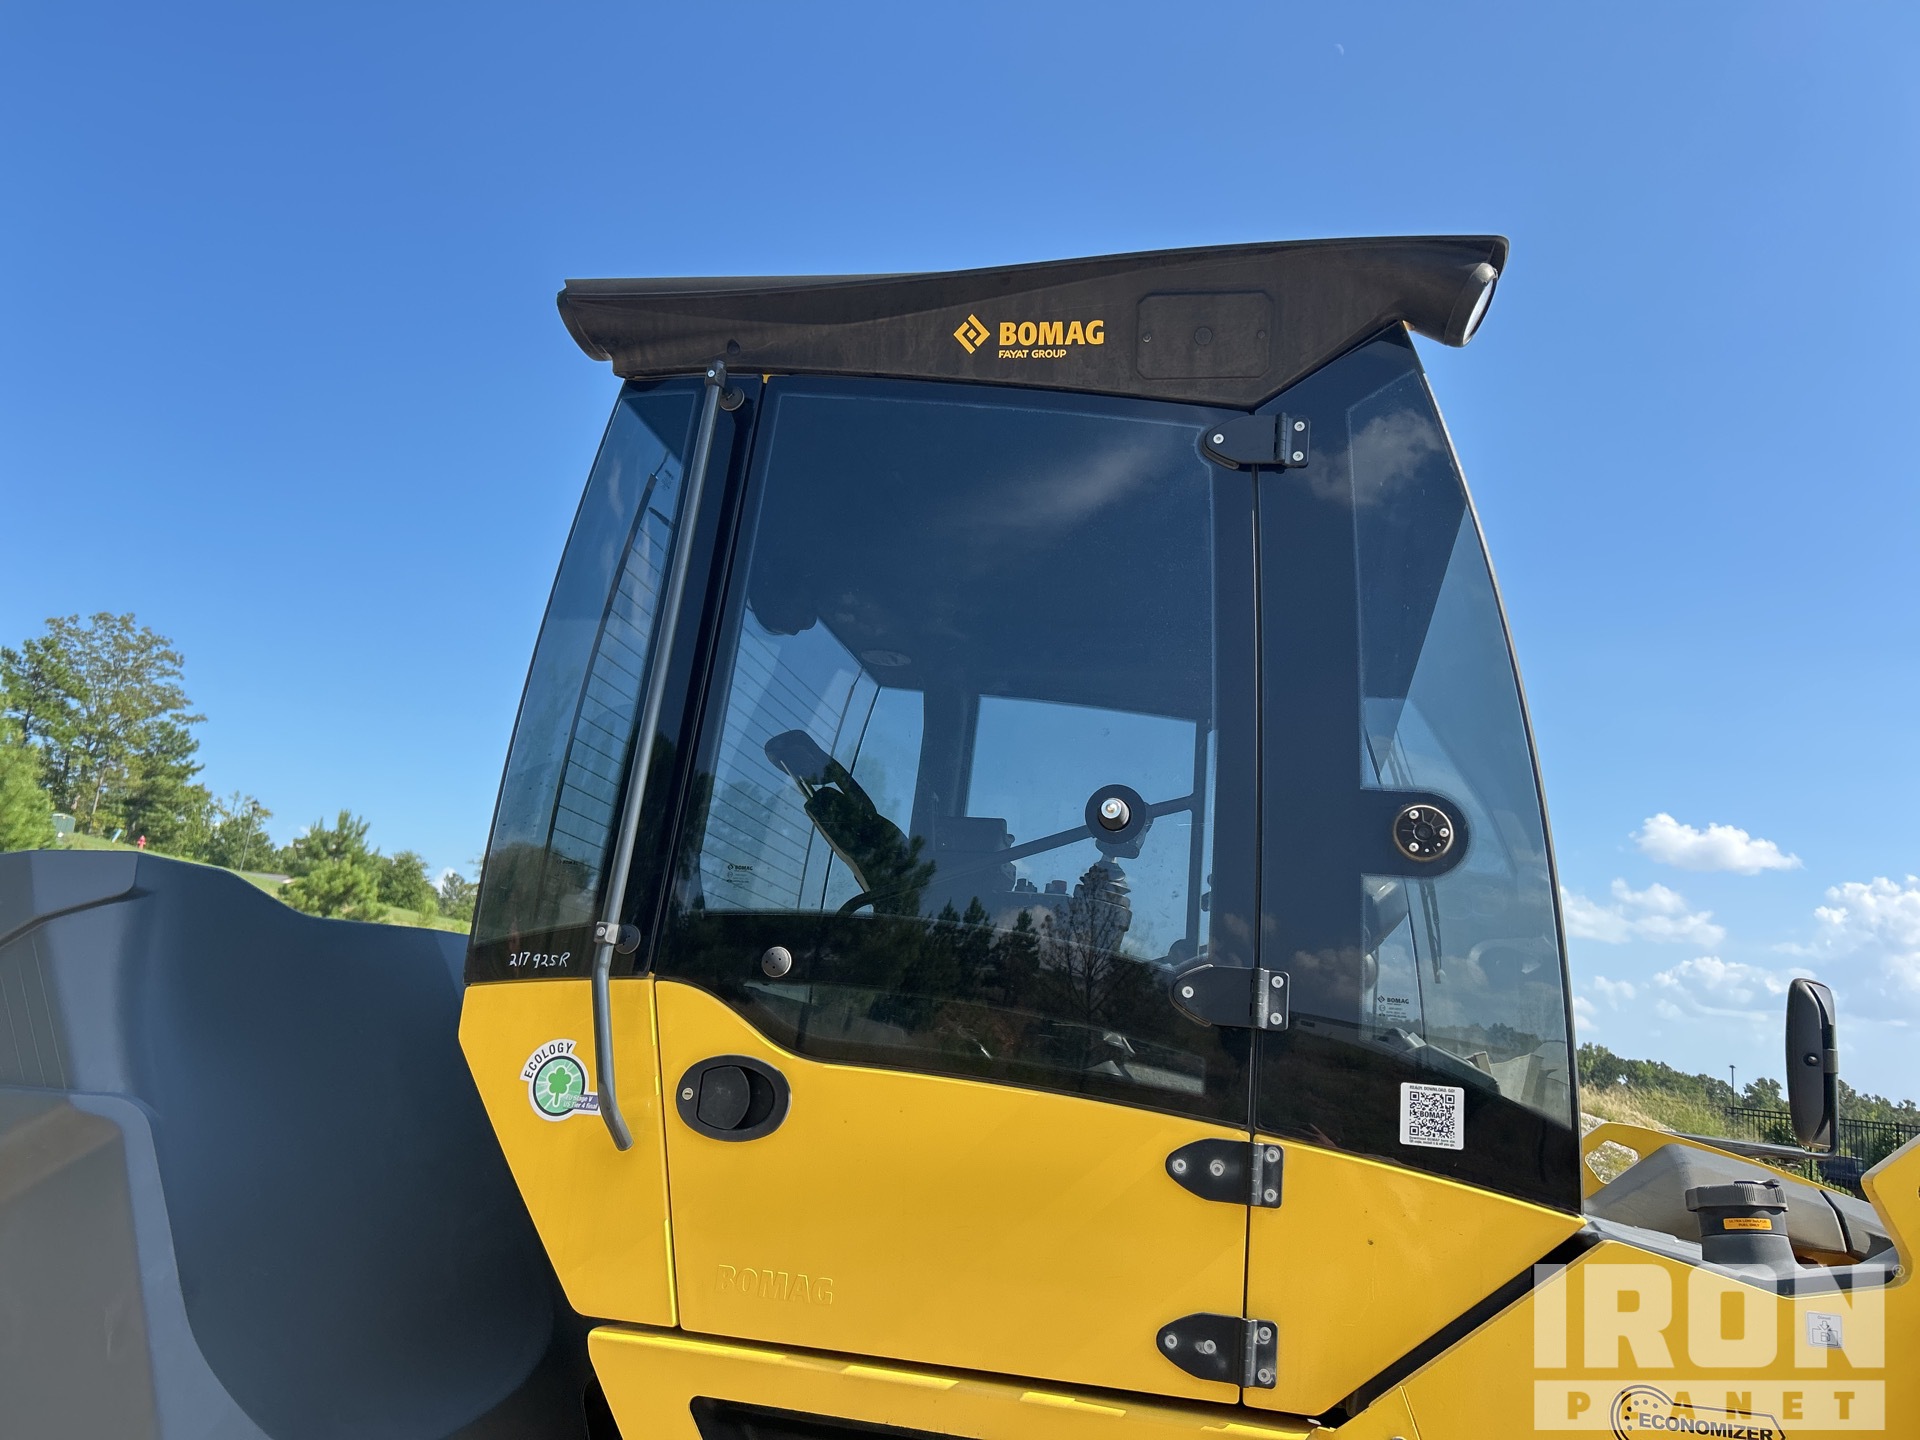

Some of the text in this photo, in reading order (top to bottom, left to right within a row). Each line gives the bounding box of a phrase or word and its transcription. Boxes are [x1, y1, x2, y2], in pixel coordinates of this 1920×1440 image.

[999, 319, 1105, 346] BOMAG
[998, 349, 1067, 358] FAYAT GROUP
[524, 1042, 573, 1079] ECOLOGY
[715, 1265, 834, 1306] BOMAG
[1638, 1412, 1774, 1440] ECONOMIZER
